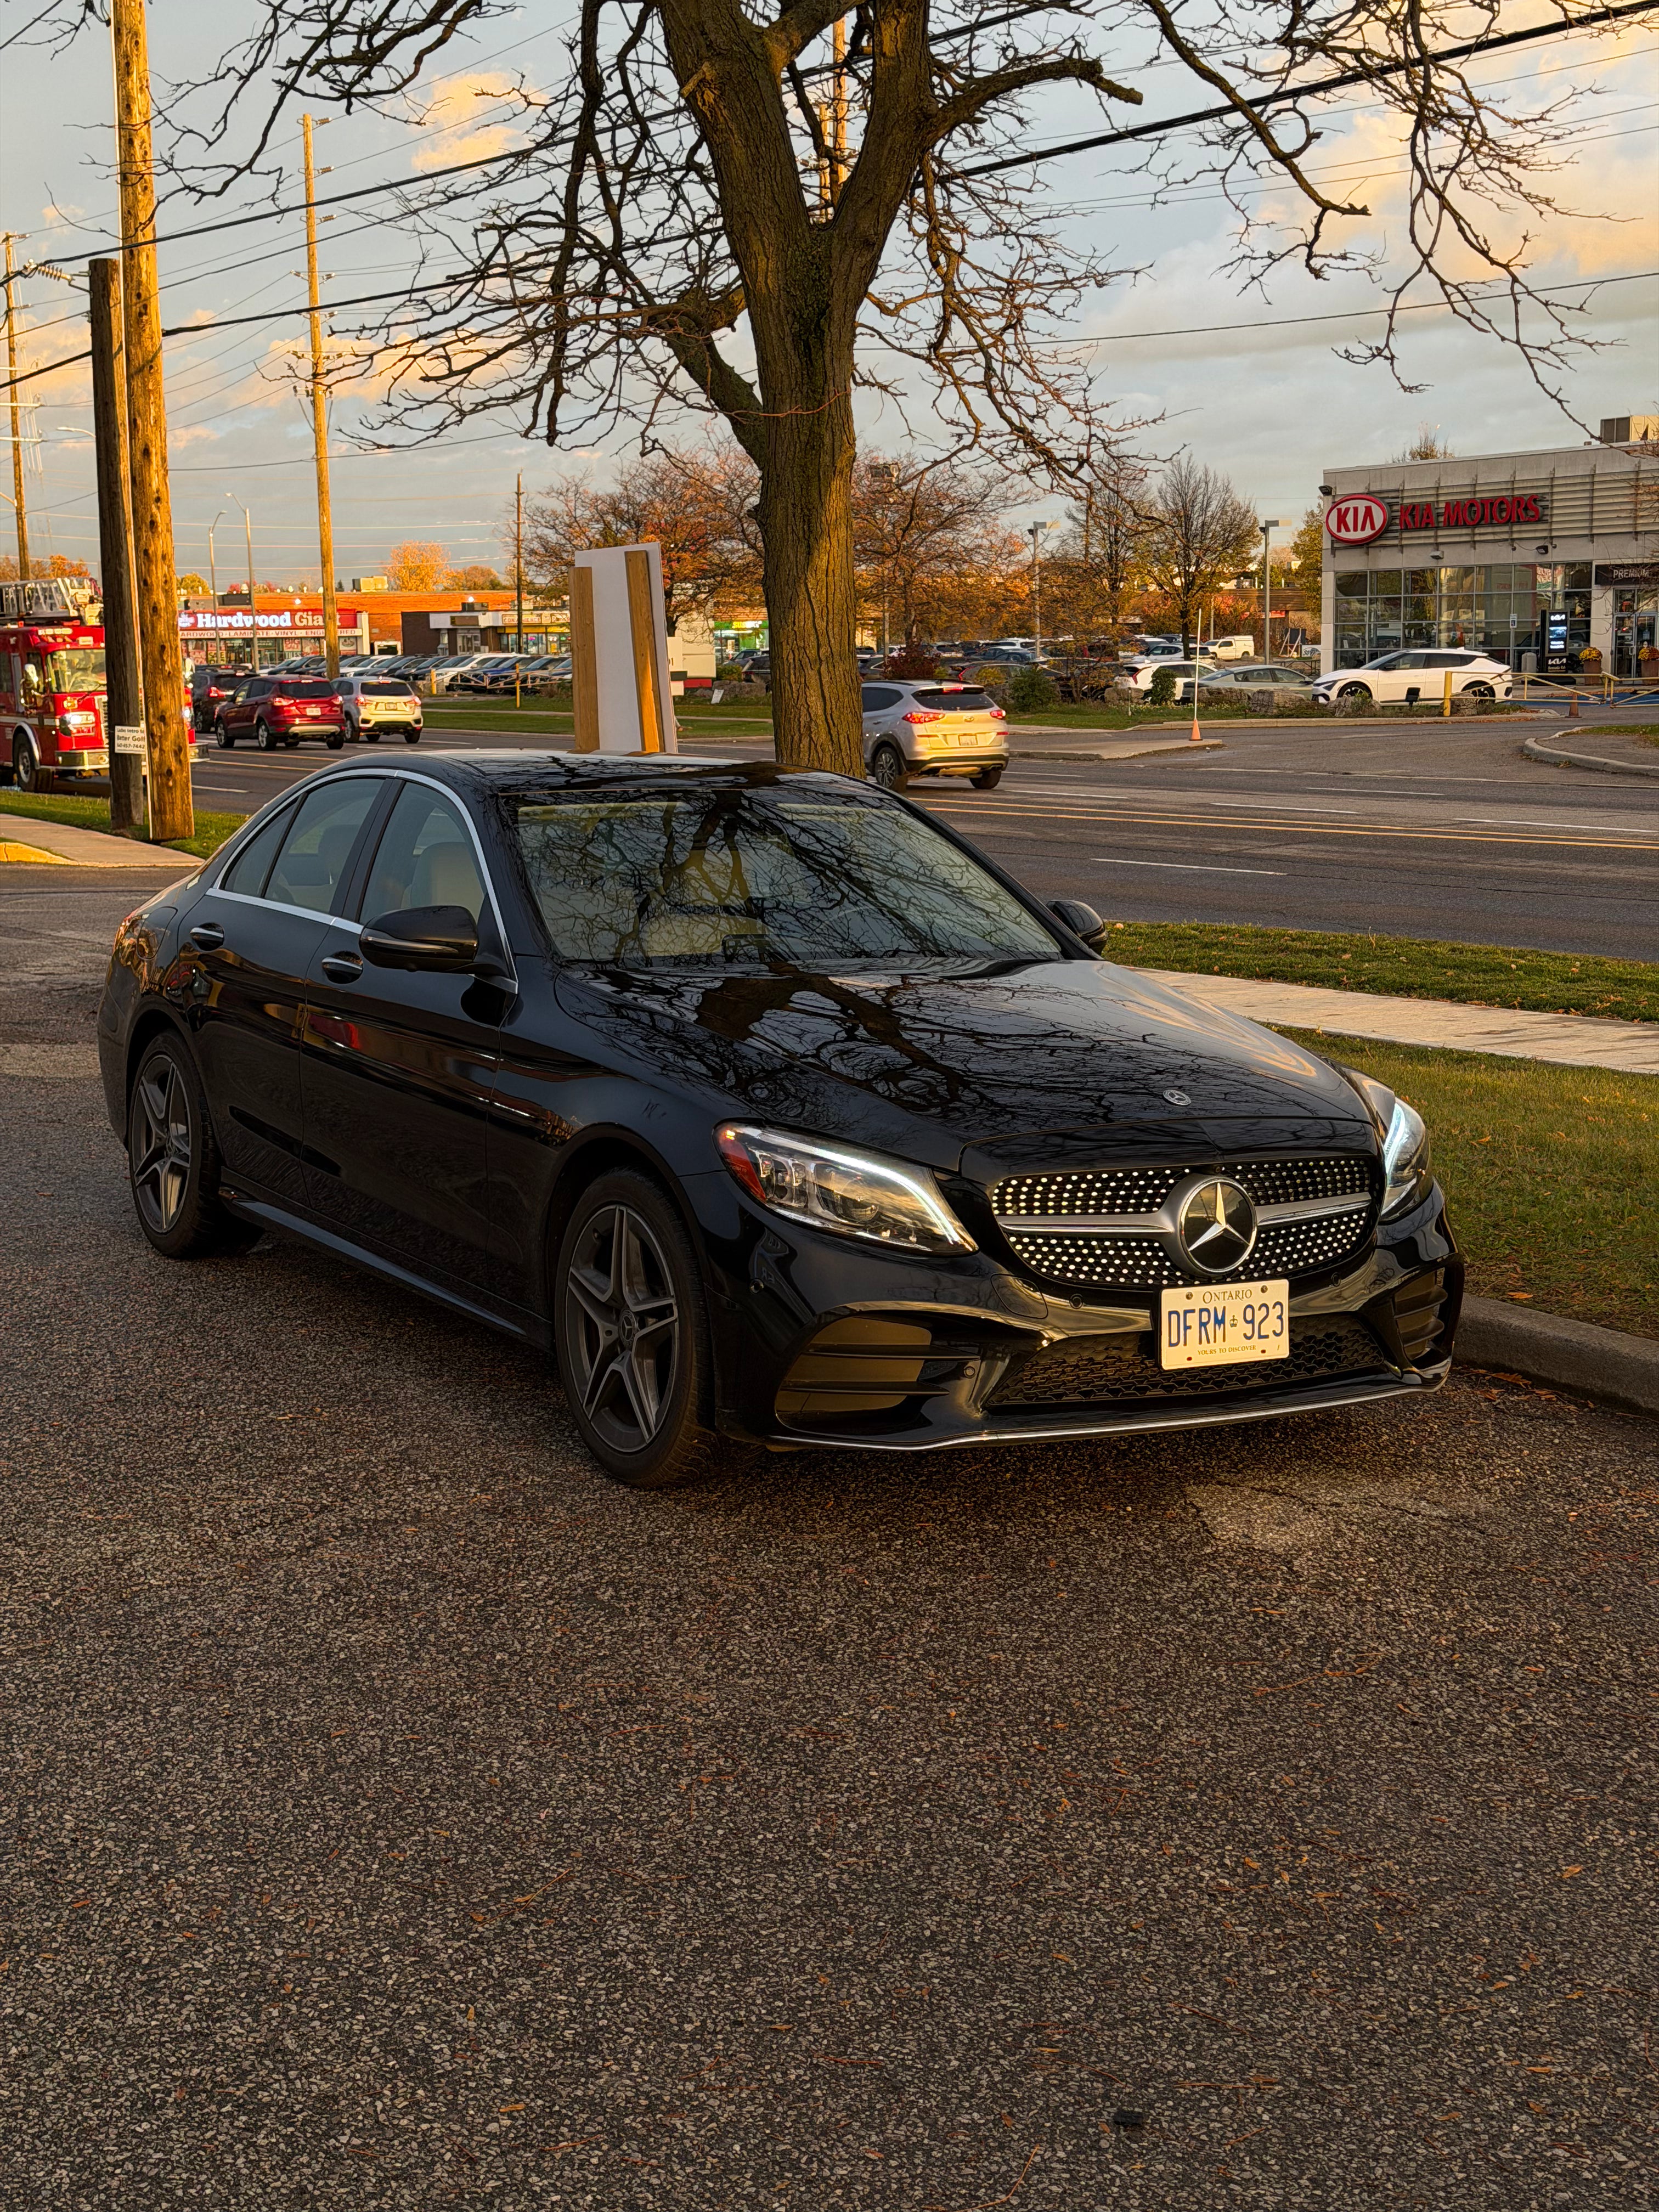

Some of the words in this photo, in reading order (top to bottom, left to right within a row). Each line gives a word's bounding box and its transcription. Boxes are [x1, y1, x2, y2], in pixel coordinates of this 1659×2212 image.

[1336, 505, 1376, 533] KIA
[1400, 503, 1435, 529] KIA
[1443, 494, 1539, 527] MOTORS
[1613, 568, 1649, 578] PREMIUM
[196, 611, 292, 628] Hardwood
[295, 611, 341, 627] Giat
[1203, 1289, 1252, 1304] ONTARIO
[1168, 1306, 1226, 1347] DFRM
[1243, 1301, 1284, 1340] 923
[1228, 1345, 1256, 1353] DISCOVER
